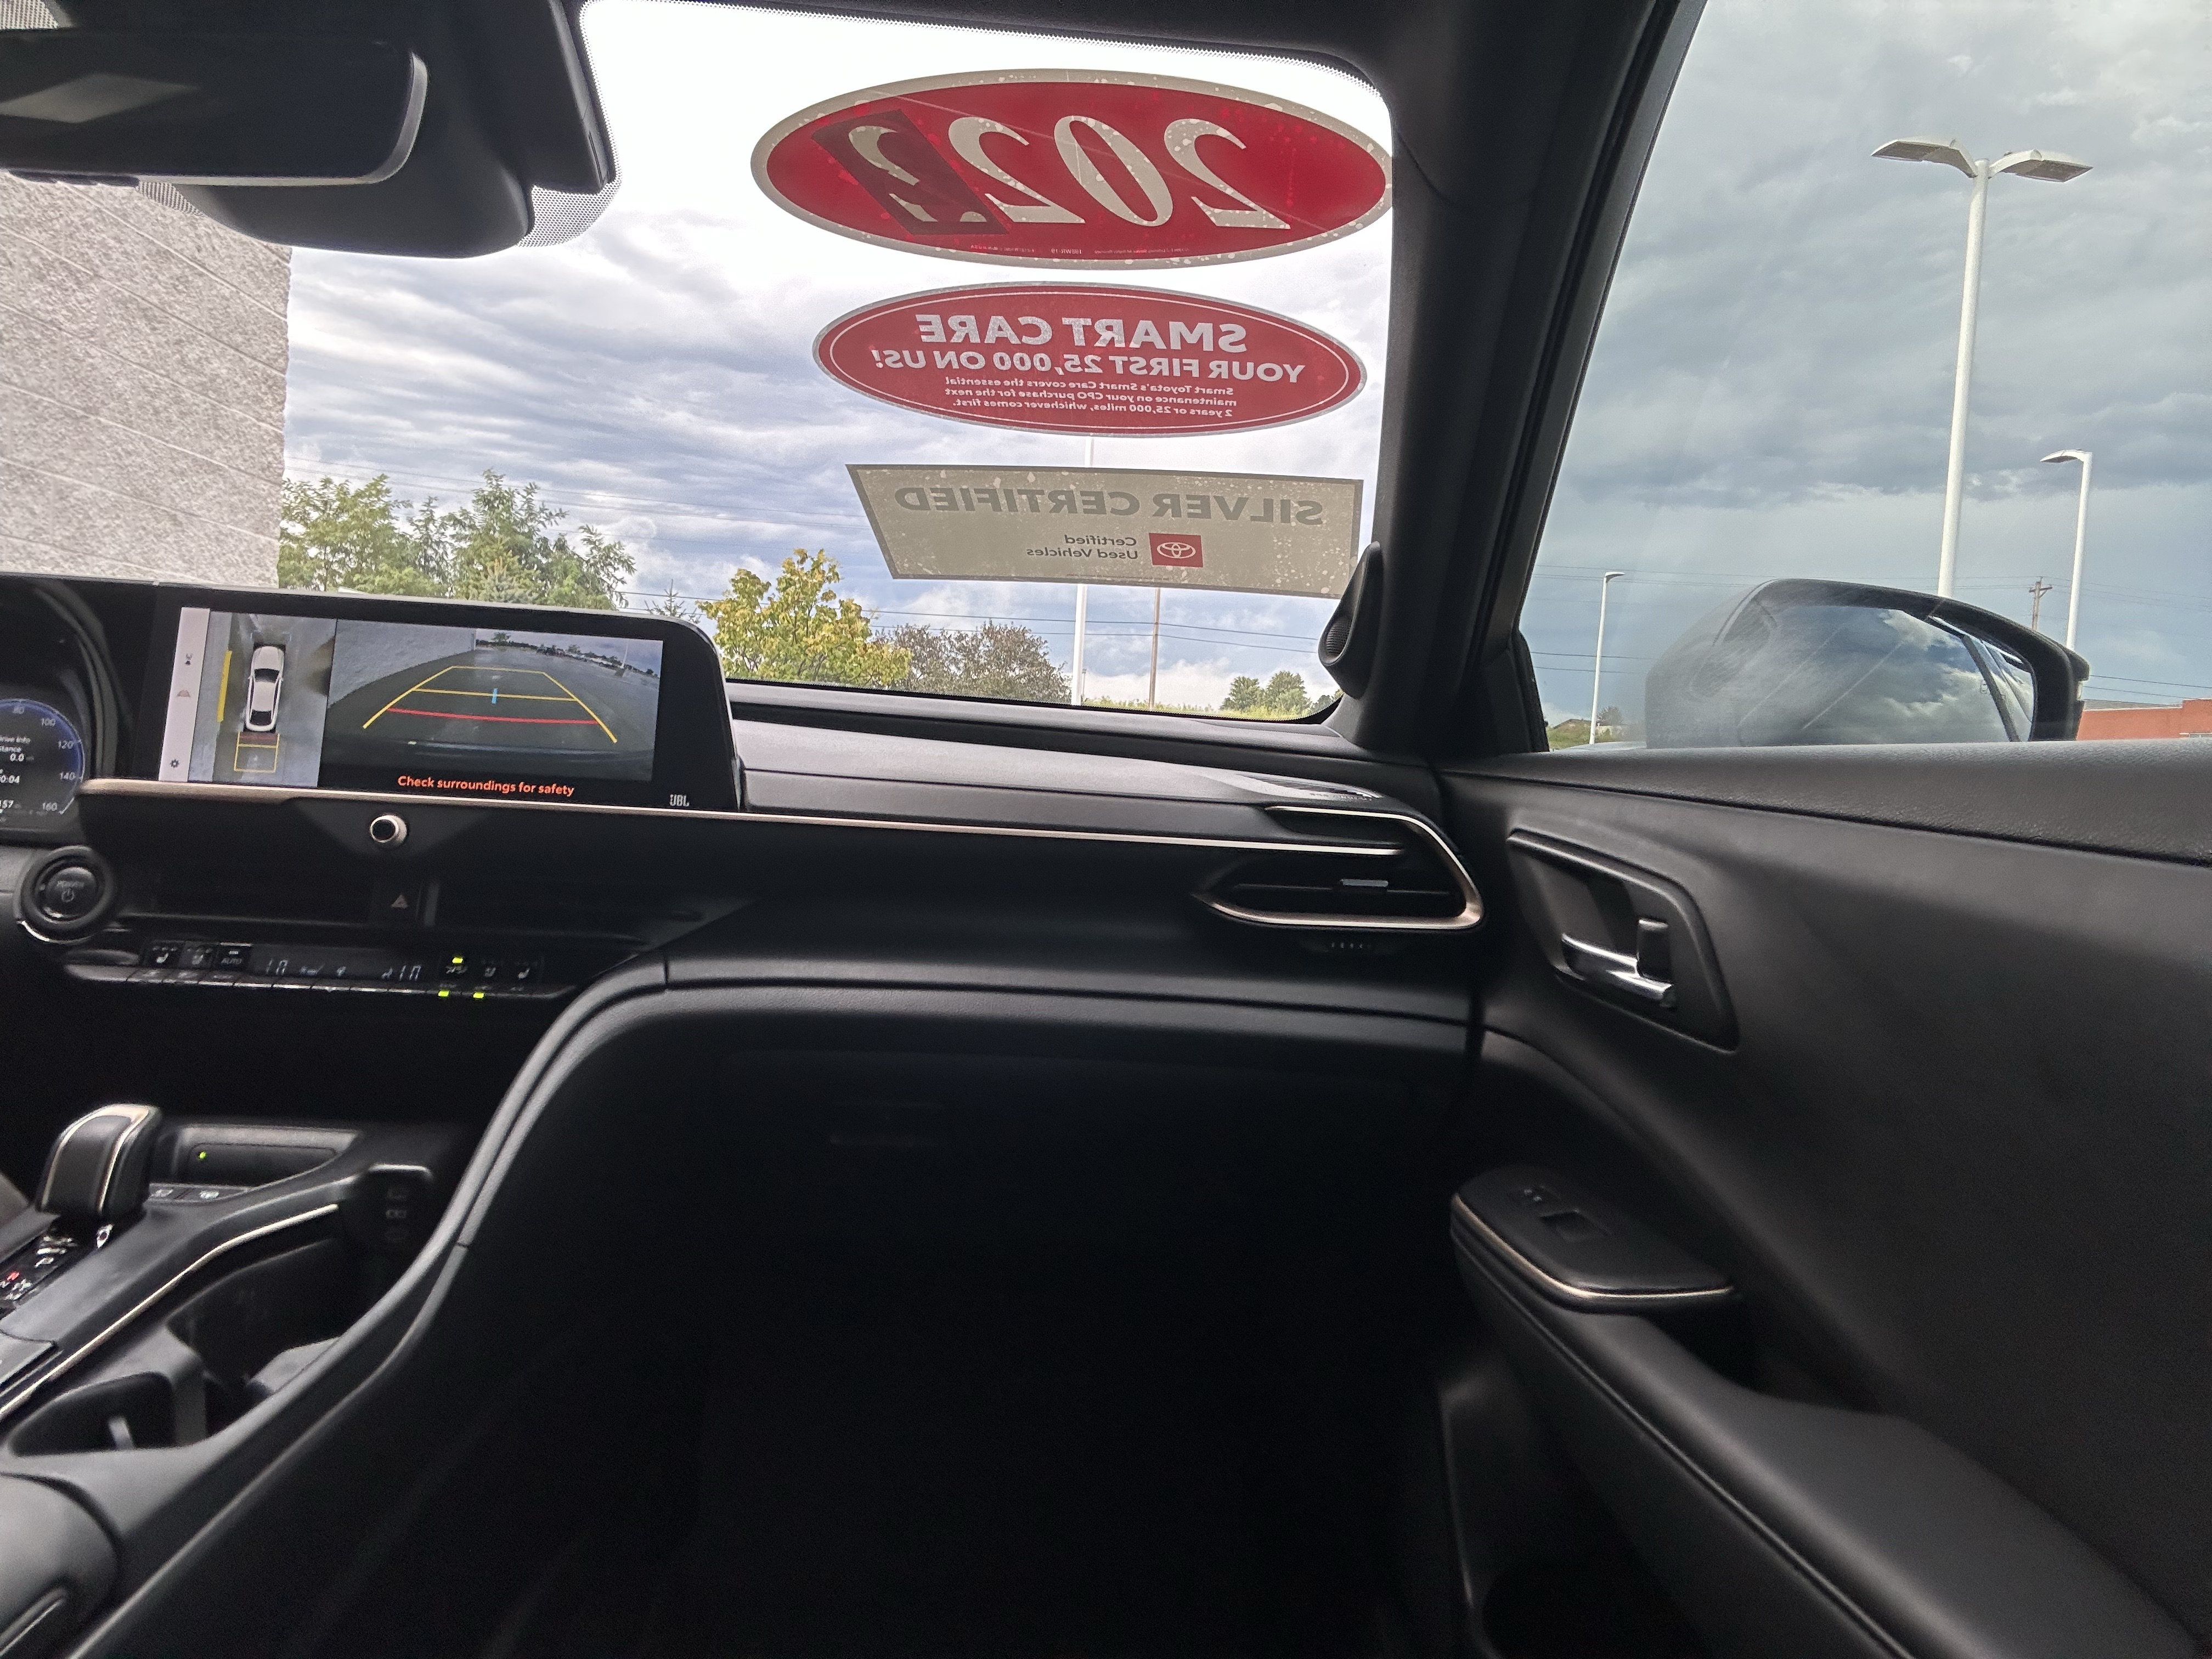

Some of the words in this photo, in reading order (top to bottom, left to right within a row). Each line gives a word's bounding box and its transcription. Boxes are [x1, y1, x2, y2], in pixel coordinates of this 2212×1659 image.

[41, 718, 56, 727] 100
[58, 741, 74, 749] 120
[10, 753, 25, 762] 0.0
[60, 772, 76, 781] 140
[398, 775, 435, 788] Check
[437, 779, 516, 794] surroundings
[518, 782, 536, 793] for
[538, 784, 574, 797] safety
[669, 794, 690, 807] JBL
[42, 802, 58, 811] 160
